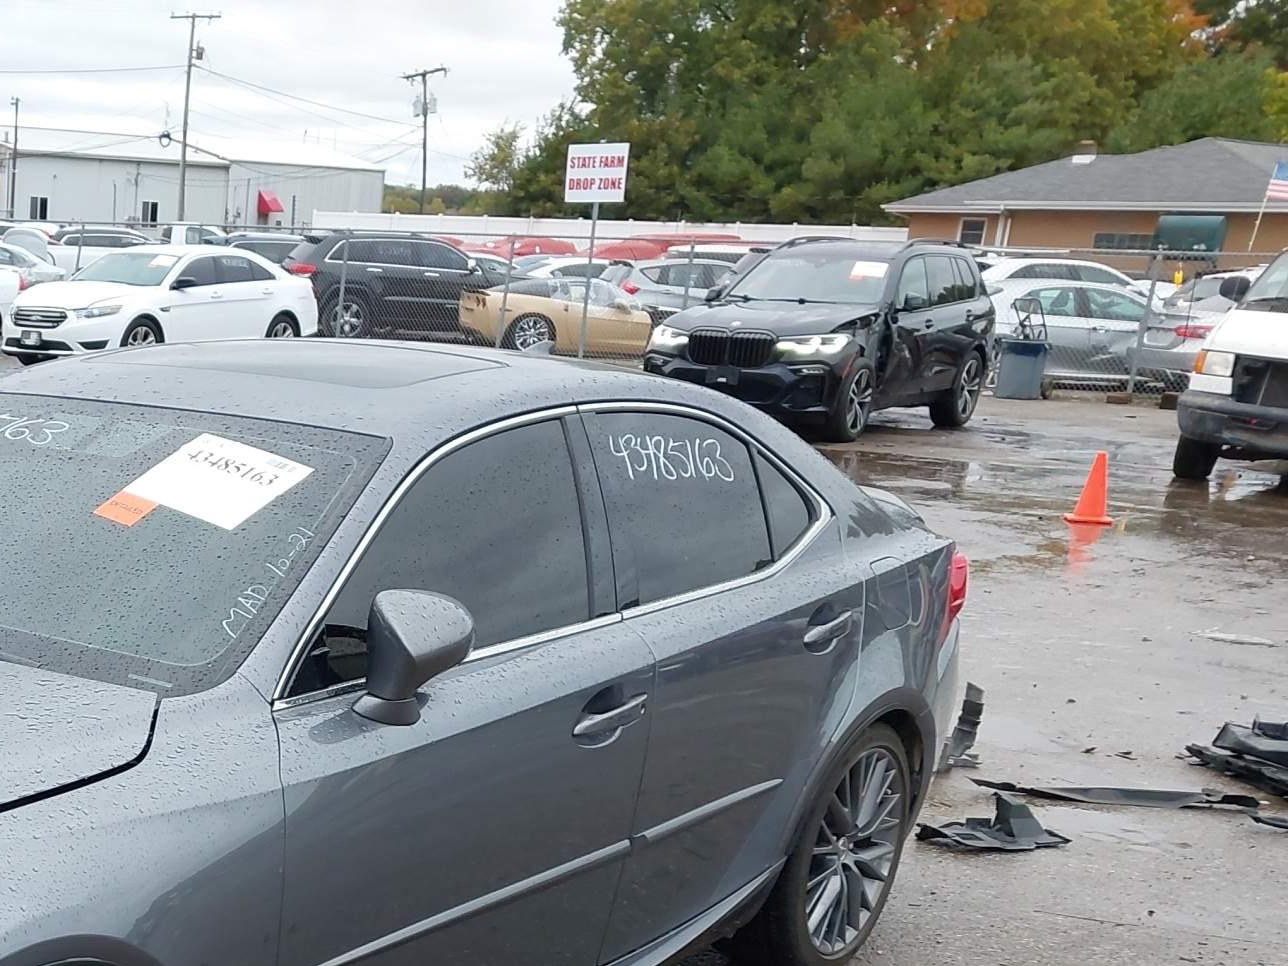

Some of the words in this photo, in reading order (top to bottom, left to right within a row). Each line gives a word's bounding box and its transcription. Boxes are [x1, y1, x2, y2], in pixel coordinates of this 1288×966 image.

[569, 156, 597, 169] STATE
[599, 155, 625, 169] FARM
[568, 178, 596, 191] DROP
[598, 177, 622, 190] ZONE
[187, 450, 279, 486] 43485163
[609, 434, 734, 481] 43485163
[222, 584, 268, 639] MAD
[265, 526, 315, 577] 10-21
